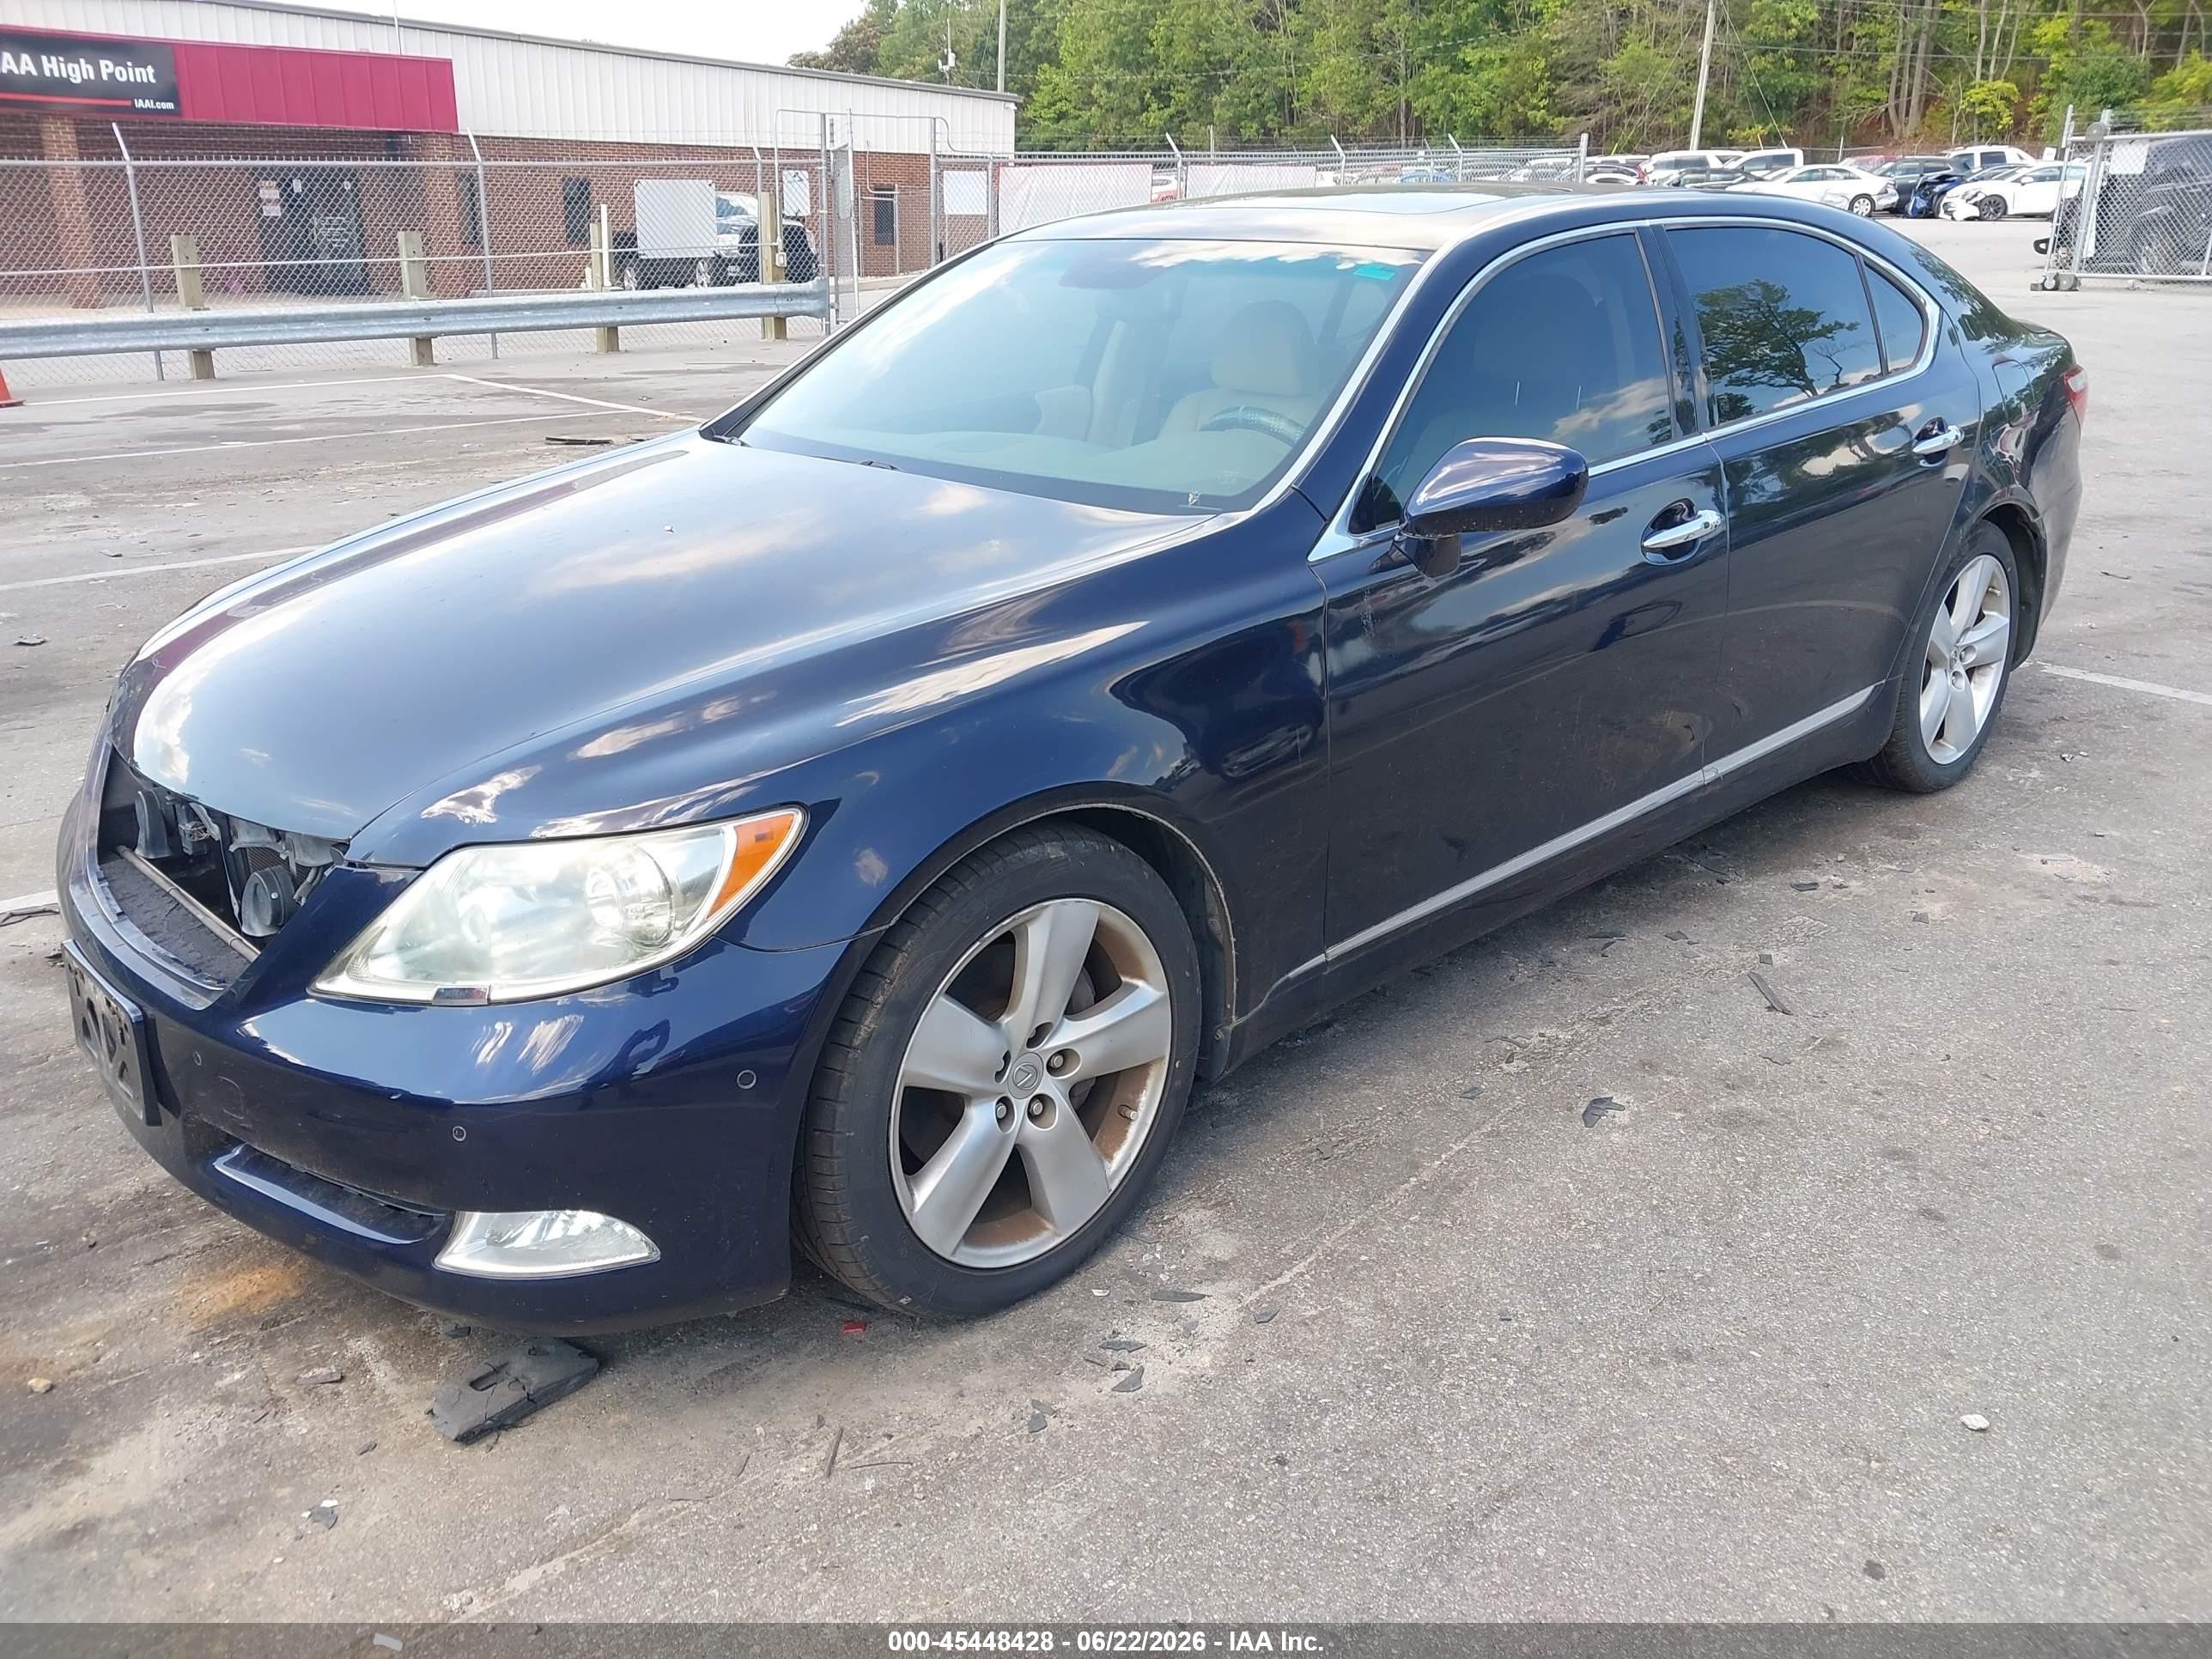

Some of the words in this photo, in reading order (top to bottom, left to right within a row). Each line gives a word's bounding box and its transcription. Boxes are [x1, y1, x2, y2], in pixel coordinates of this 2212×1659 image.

[0, 51, 38, 76] AA
[41, 55, 94, 83] High
[99, 59, 156, 83] Point
[134, 98, 174, 110] IAAI.com
